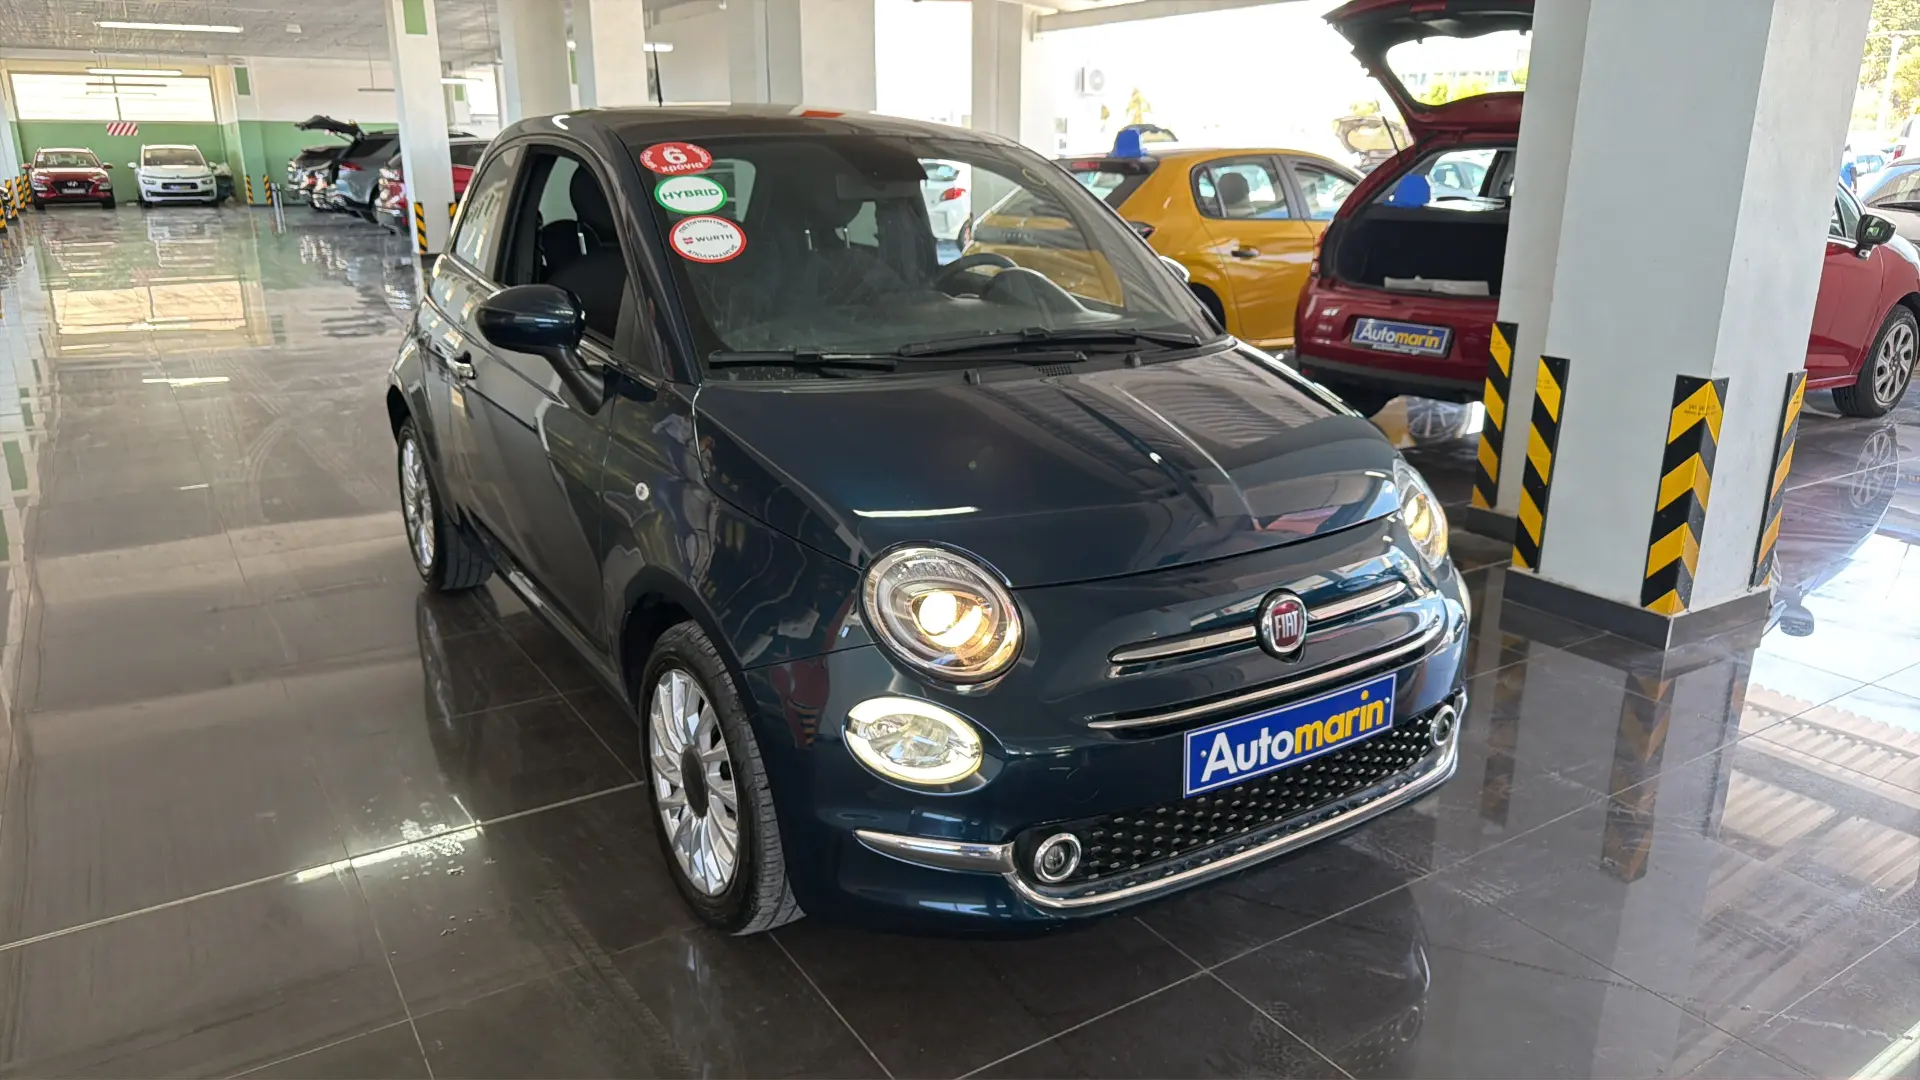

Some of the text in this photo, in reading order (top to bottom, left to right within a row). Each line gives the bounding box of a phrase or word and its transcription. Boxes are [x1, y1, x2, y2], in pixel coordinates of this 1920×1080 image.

[663, 147, 687, 164] 6
[662, 189, 719, 200] HYBRID
[1358, 321, 1440, 348] Automarin
[1274, 610, 1299, 640] FIAT
[1200, 690, 1385, 783] Automarin
